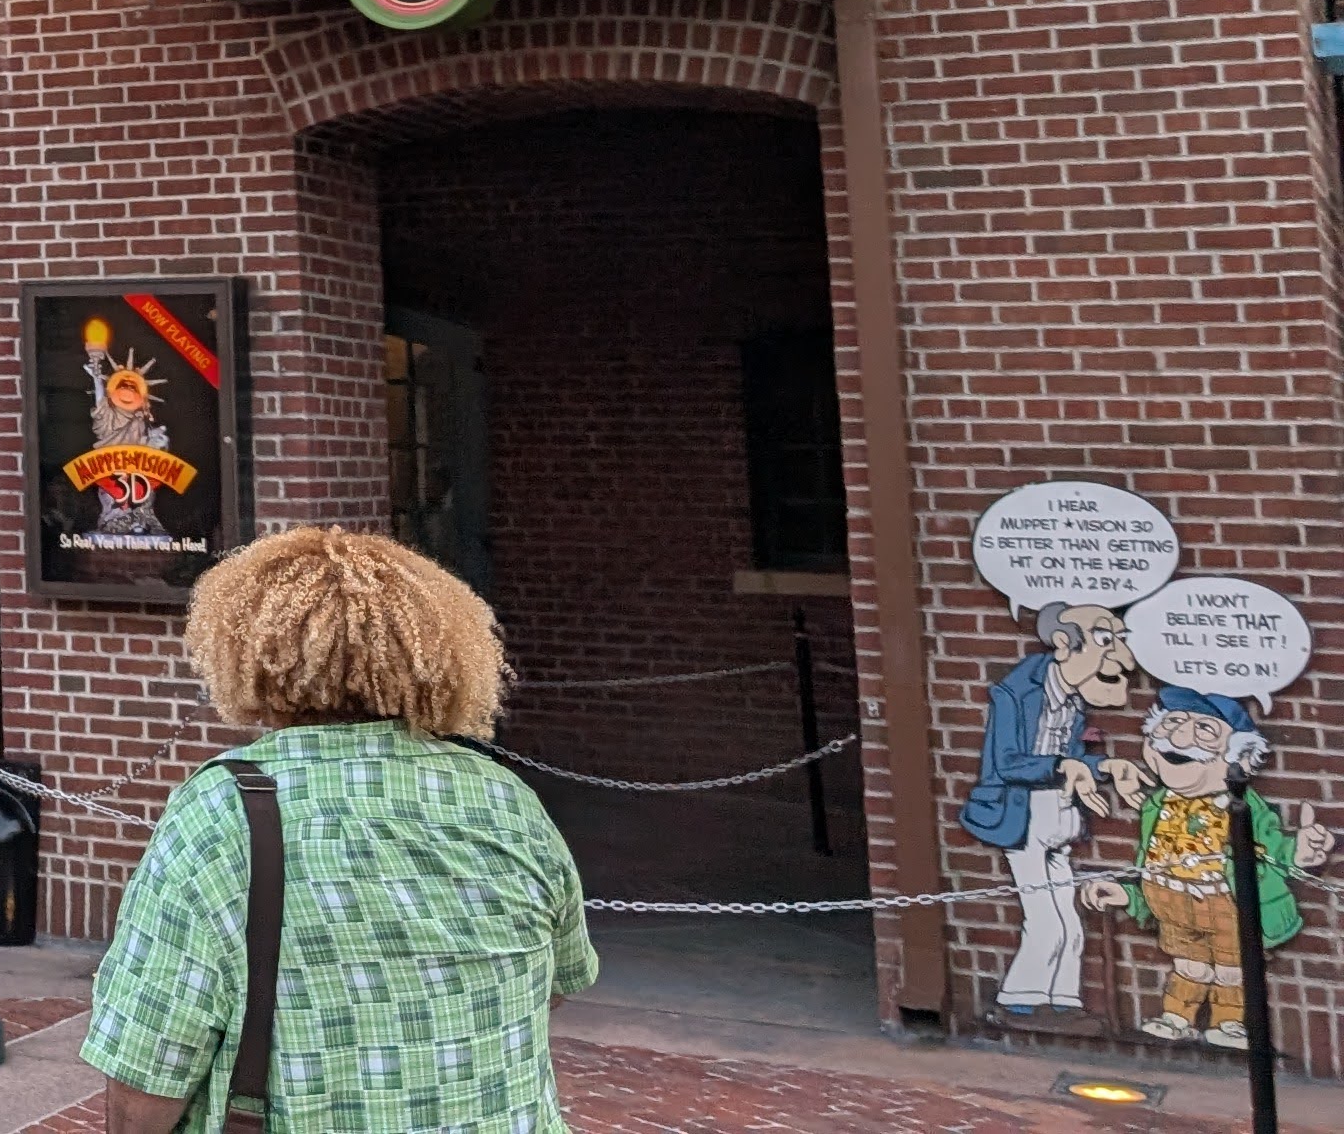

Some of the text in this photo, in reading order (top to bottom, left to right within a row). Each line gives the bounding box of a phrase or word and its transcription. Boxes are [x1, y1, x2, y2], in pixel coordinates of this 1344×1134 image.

[141, 301, 211, 369] NOW PLAYING
[112, 470, 151, 503] 3D
[1048, 500, 1099, 513] I HEAR
[1000, 517, 1154, 533] MUPPET VISION 3D
[59, 533, 72, 548] So
[124, 535, 151, 550] Think
[980, 536, 1174, 553] IS BETTER THAN GETTING
[1009, 555, 1150, 571] HIT ON THE HEAD
[1024, 574, 1064, 588] WITH
[1070, 575, 1084, 589] A
[1087, 576, 1099, 590] 2
[1187, 594, 1250, 608] I WON'T
[1166, 612, 1283, 632] BELIEVE THAT
[1161, 632, 1194, 646] TILL
[1202, 633, 1208, 647] I
[1216, 634, 1249, 648] SEE
[1173, 660, 1218, 676] LET'S
[1224, 662, 1251, 677] GO
